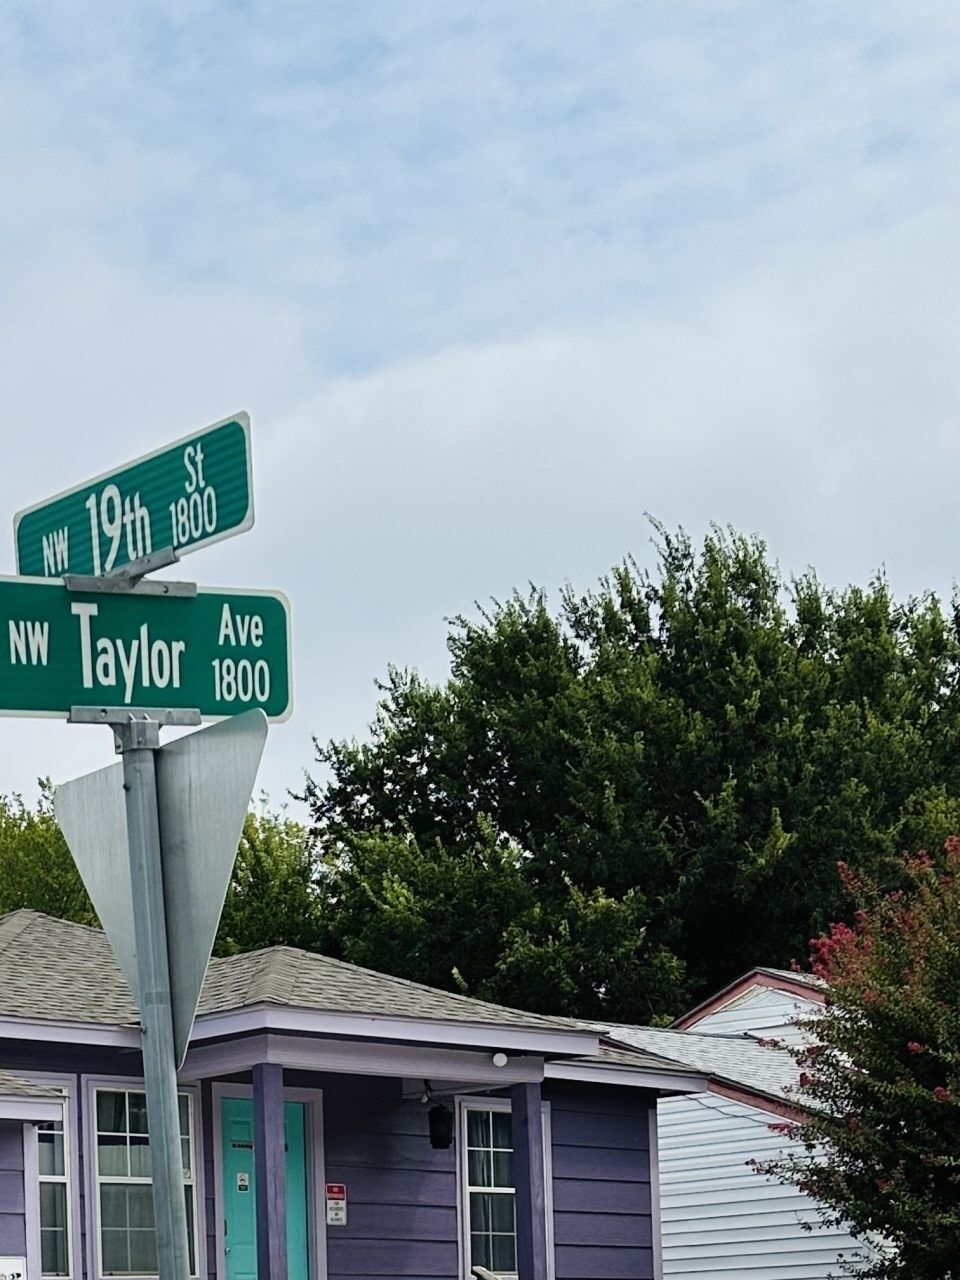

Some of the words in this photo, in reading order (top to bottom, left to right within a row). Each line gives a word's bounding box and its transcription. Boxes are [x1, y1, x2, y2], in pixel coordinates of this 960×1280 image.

[183, 442, 206, 493] St
[42, 526, 69, 577] NW
[85, 484, 152, 577] 19th
[169, 486, 217, 547] 1800
[218, 603, 264, 648] Ave
[9, 620, 49, 666] NW
[70, 602, 186, 703] Taylor
[211, 658, 270, 703] 1800
